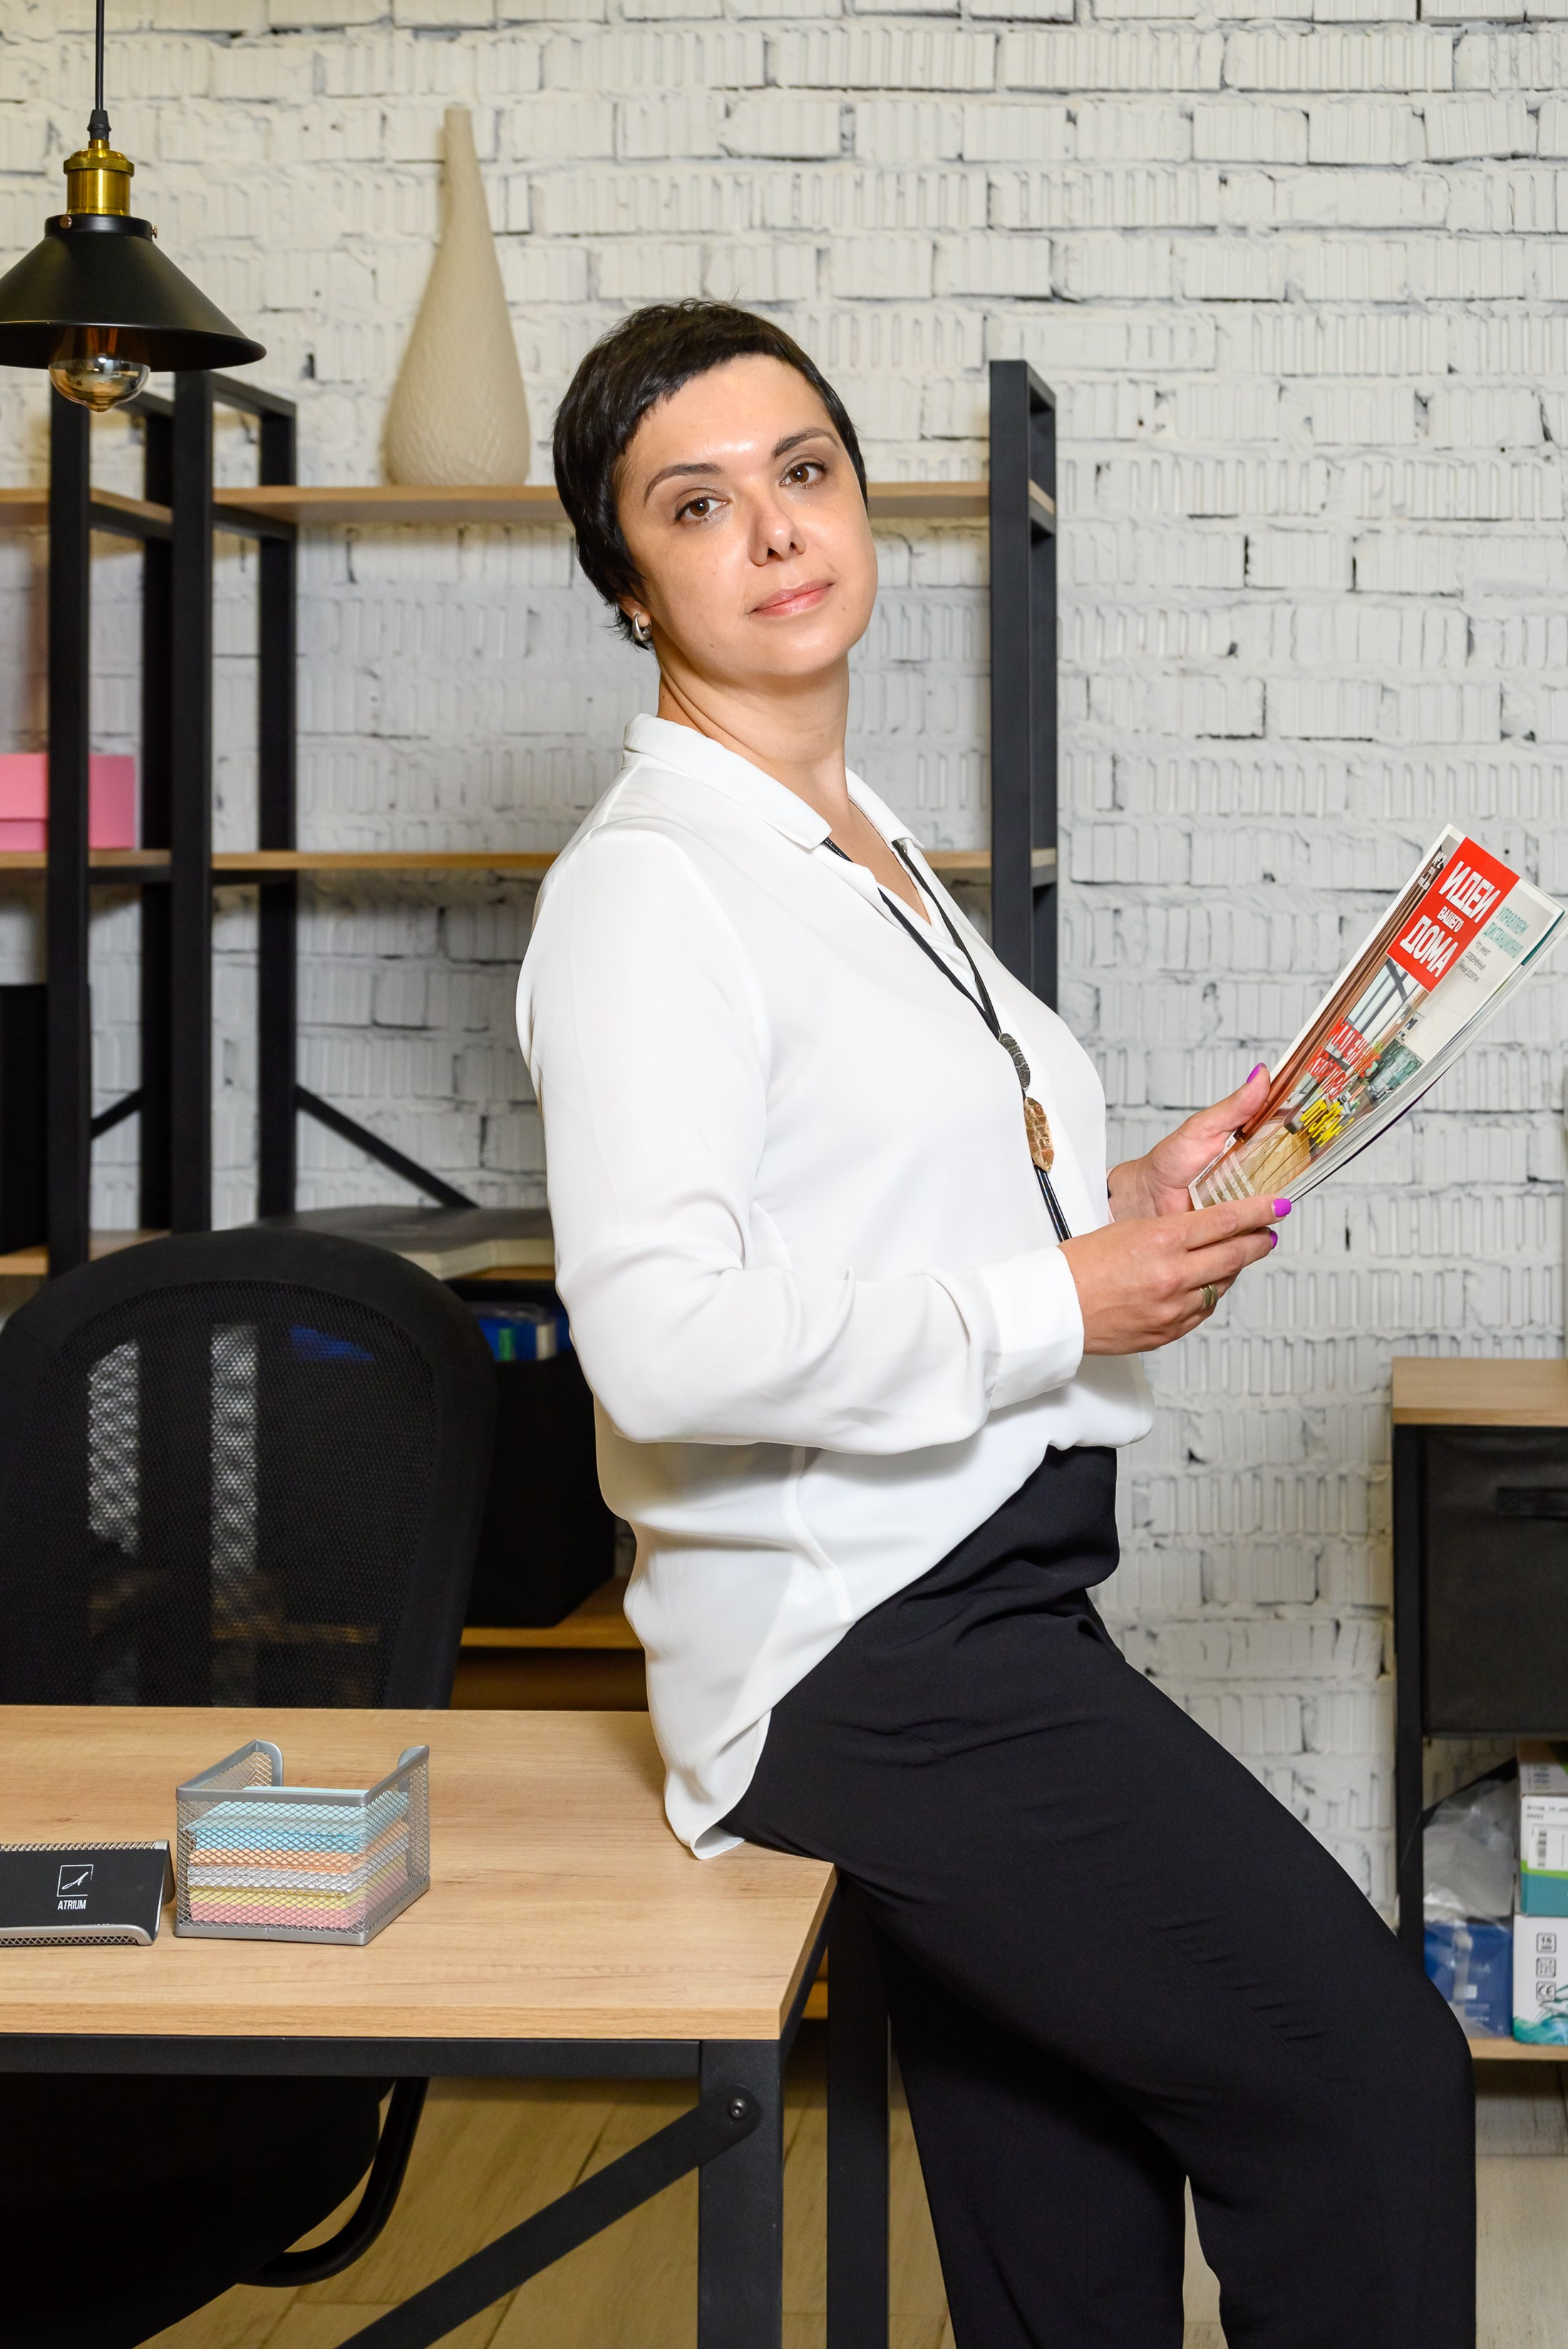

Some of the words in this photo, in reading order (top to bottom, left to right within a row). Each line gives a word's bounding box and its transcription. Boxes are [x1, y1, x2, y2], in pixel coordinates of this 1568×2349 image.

[1436, 906, 1465, 933] ВАШЕГО
[1438, 860, 1501, 924] ИДЕИ
[1398, 914, 1459, 978] ДОМА
[1305, 1046, 1351, 1100] КВАРТИРЫ
[1326, 1016, 1381, 1078] МАЛЕНЬКИЕ
[57, 1899, 87, 1910] ATRIUM
